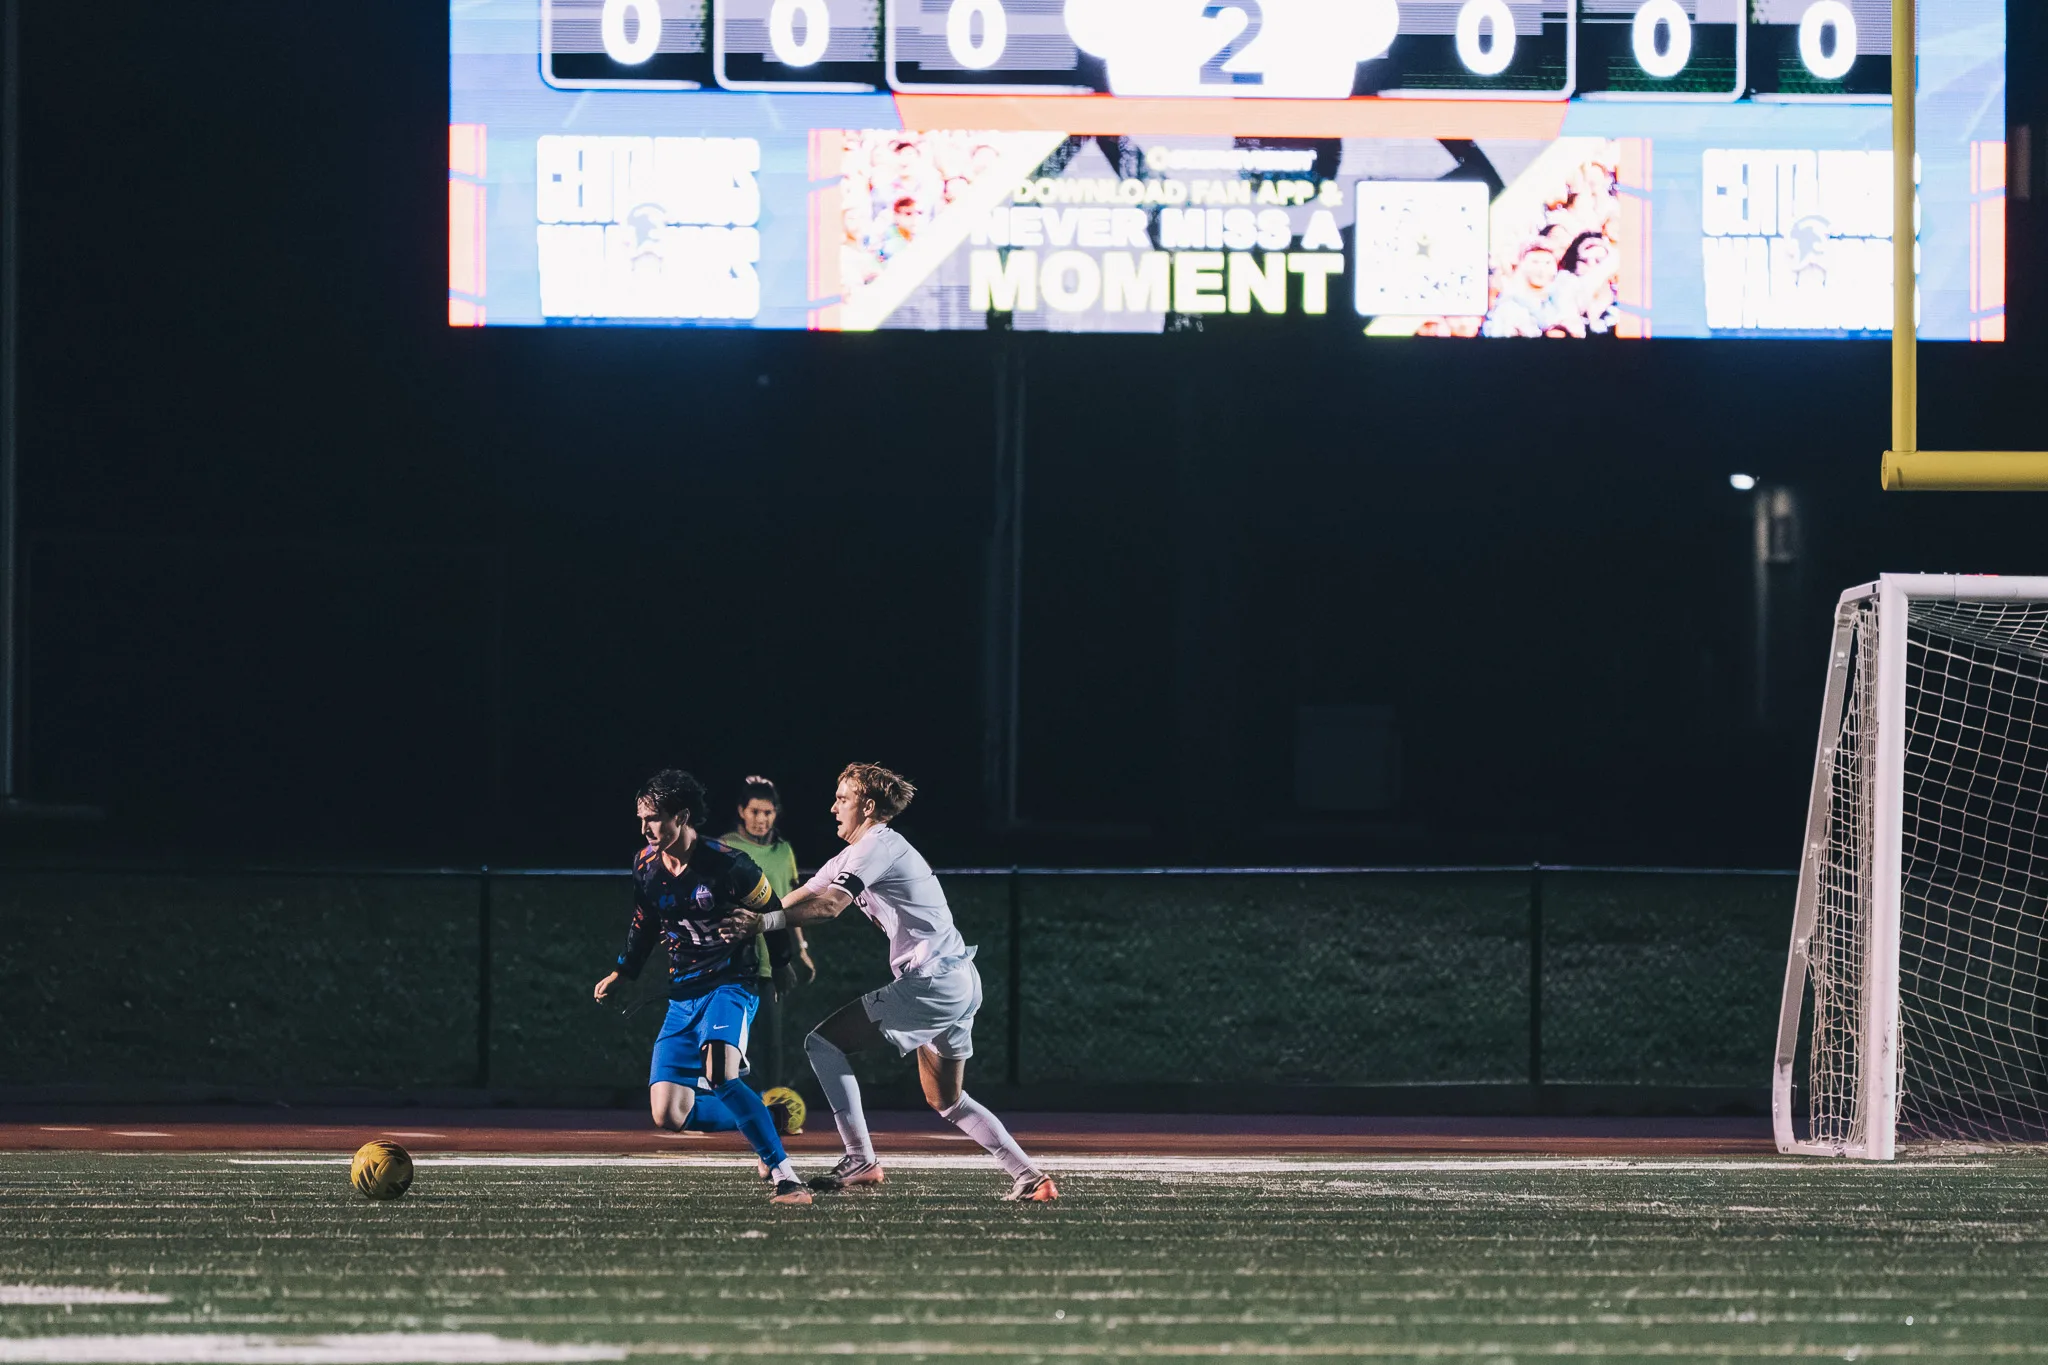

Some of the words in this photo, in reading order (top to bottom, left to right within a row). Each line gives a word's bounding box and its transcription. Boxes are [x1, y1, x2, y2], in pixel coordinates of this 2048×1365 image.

[601, 0, 661, 65] 0
[769, 0, 829, 67] 0
[947, 0, 1007, 69] 0
[1199, 0, 1263, 85] 2
[1457, 0, 1516, 75] 0
[1633, 0, 1692, 77] 0
[1799, 0, 1857, 79] 0
[1013, 177, 1188, 205] DOWNLOAD
[1192, 179, 1251, 205] FAN
[1257, 180, 1315, 206] APP
[1318, 180, 1343, 207] &
[970, 206, 1151, 248] NEVER
[1158, 208, 1292, 250] MISS
[1301, 210, 1344, 250] A
[968, 249, 1345, 314] MOMENT
